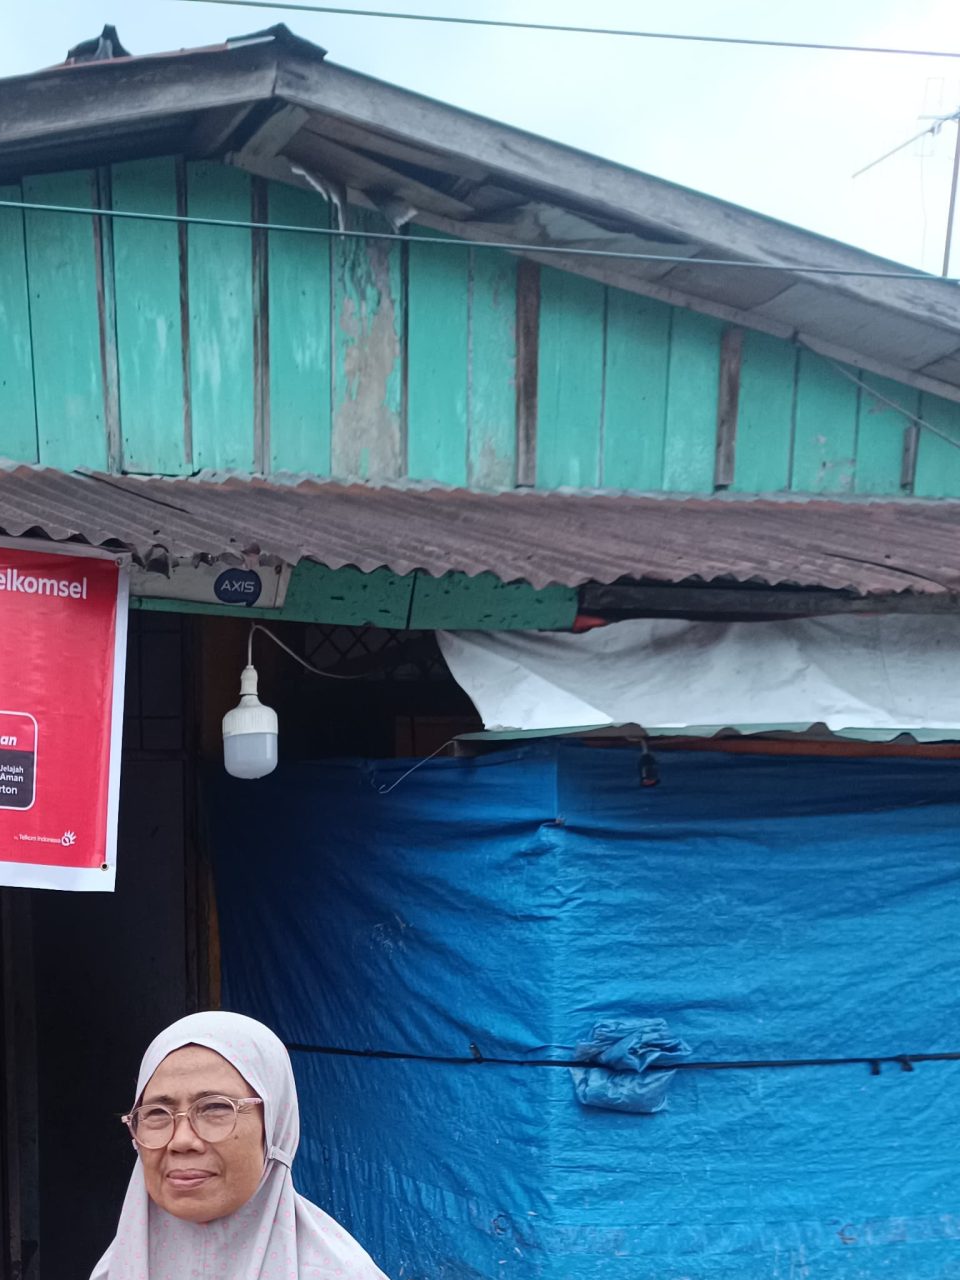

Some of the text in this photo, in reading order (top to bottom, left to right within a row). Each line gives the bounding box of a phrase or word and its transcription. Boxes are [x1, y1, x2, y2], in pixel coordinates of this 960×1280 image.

[220, 580, 255, 593] AXIS
[0, 764, 24, 774] Jelajah
[0, 773, 24, 782] Aman
